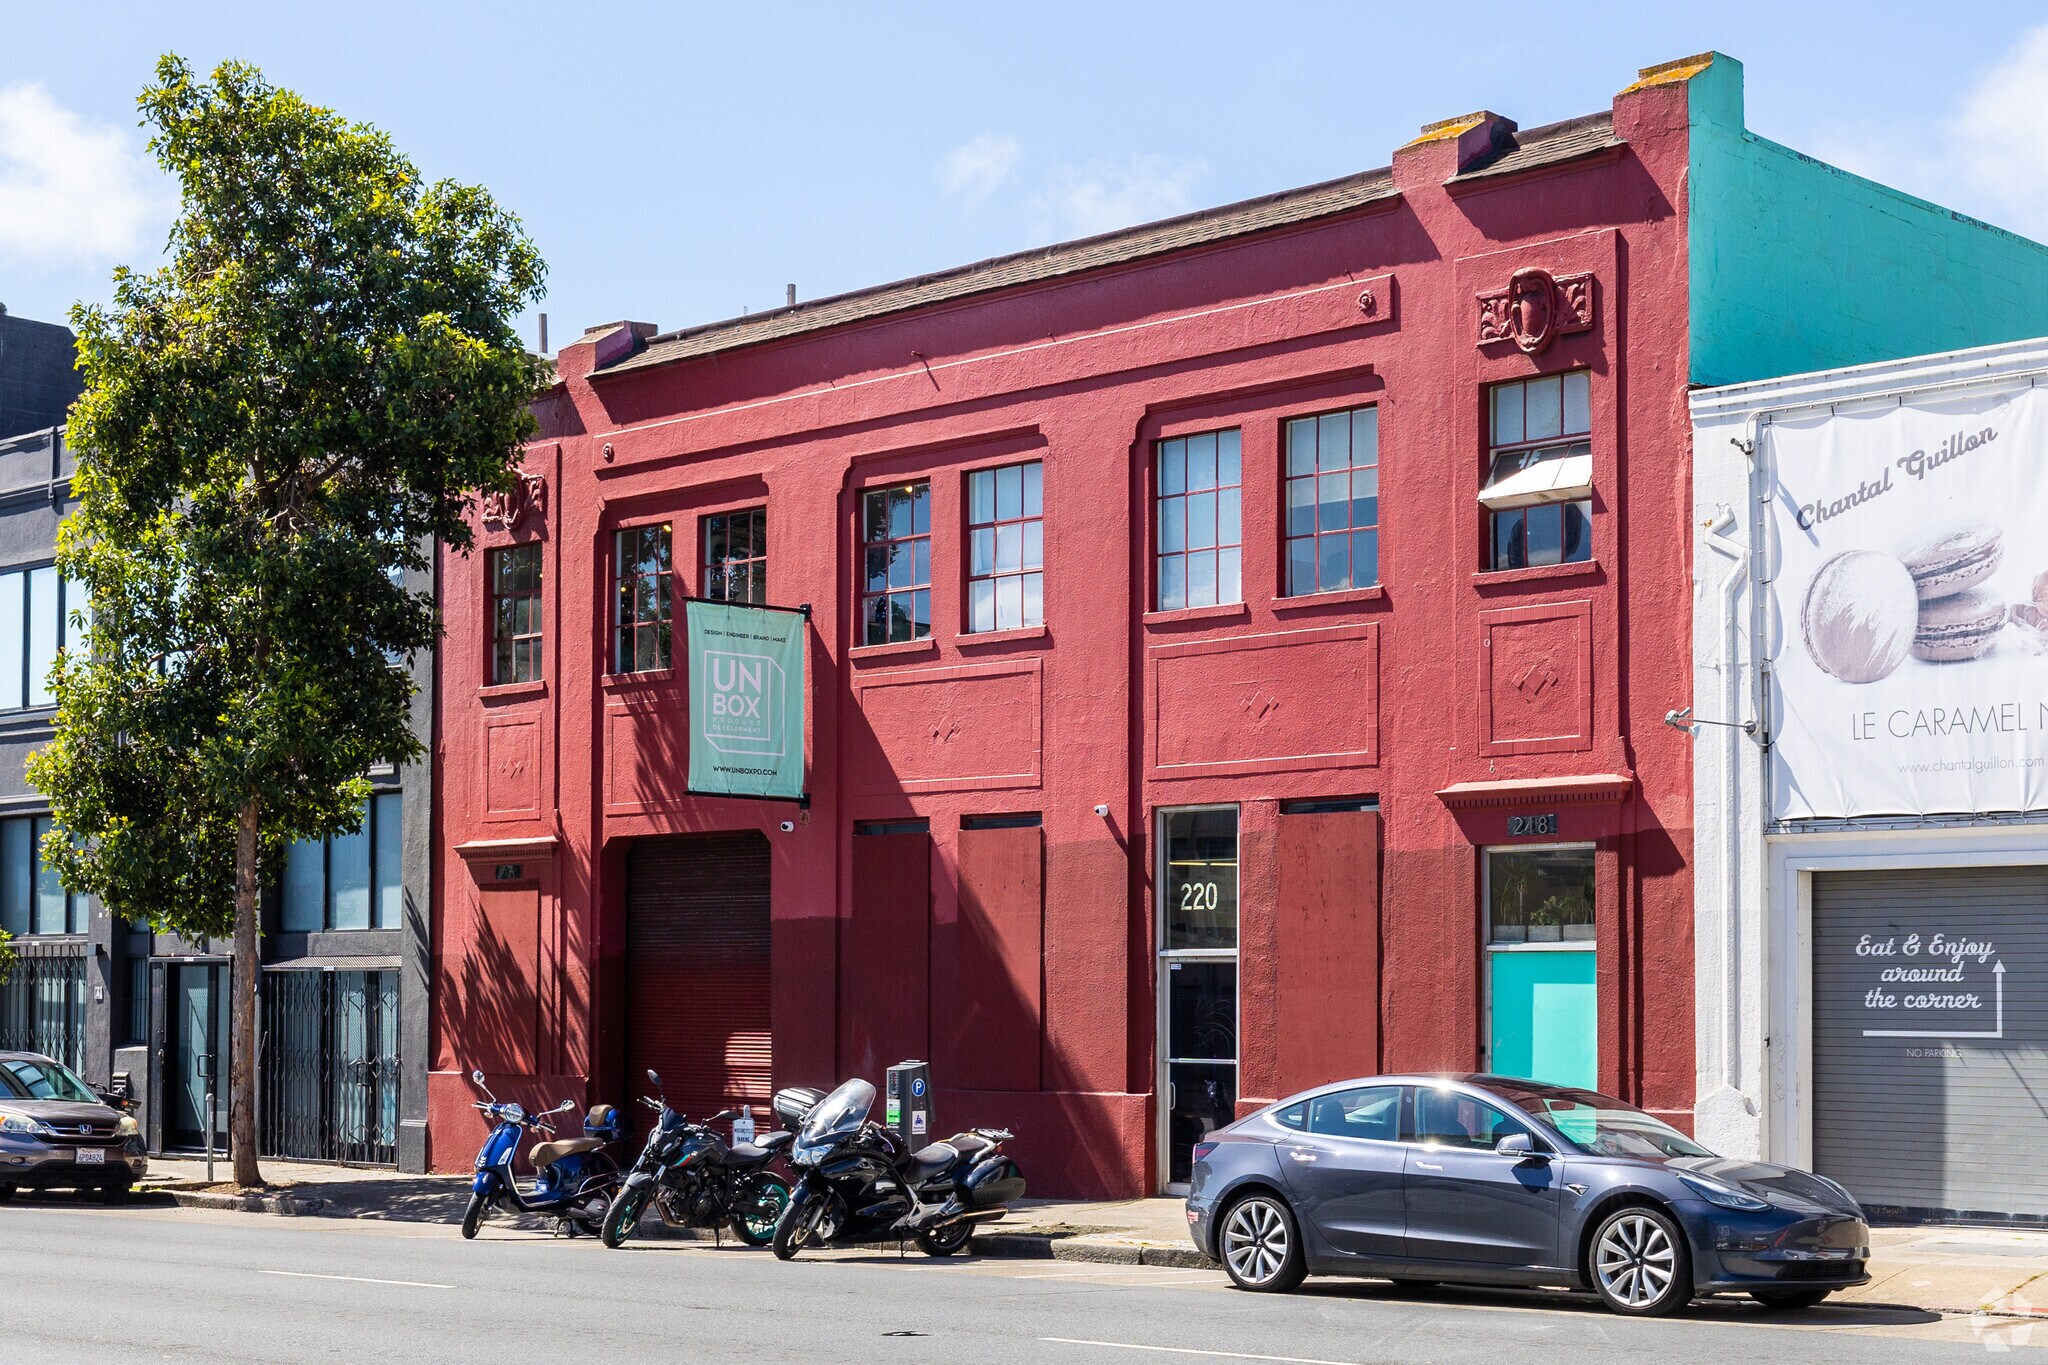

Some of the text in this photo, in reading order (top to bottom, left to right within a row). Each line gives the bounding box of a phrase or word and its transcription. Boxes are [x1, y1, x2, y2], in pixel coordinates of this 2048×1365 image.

[1797, 426, 1999, 531] Chantal Guillon
[726, 631, 750, 640] ENGINEER
[713, 658, 762, 695] UN
[712, 693, 761, 719] BOX
[712, 717, 761, 726] PRODUCT
[712, 724, 761, 733] DEVELOPMENT
[1853, 712, 1876, 741] LE
[1888, 702, 2028, 738] CARAMEL
[712, 765, 778, 776] WWW.UNBOXPD.COM
[1898, 755, 2045, 774] www.chantalguillon.com
[1180, 882, 1218, 911] 220
[1855, 933, 1996, 964] Eat & Enjoy
[1880, 961, 1965, 982] around
[1864, 987, 1982, 1009] the corner
[1906, 1048, 1962, 1059] NO PARKING
